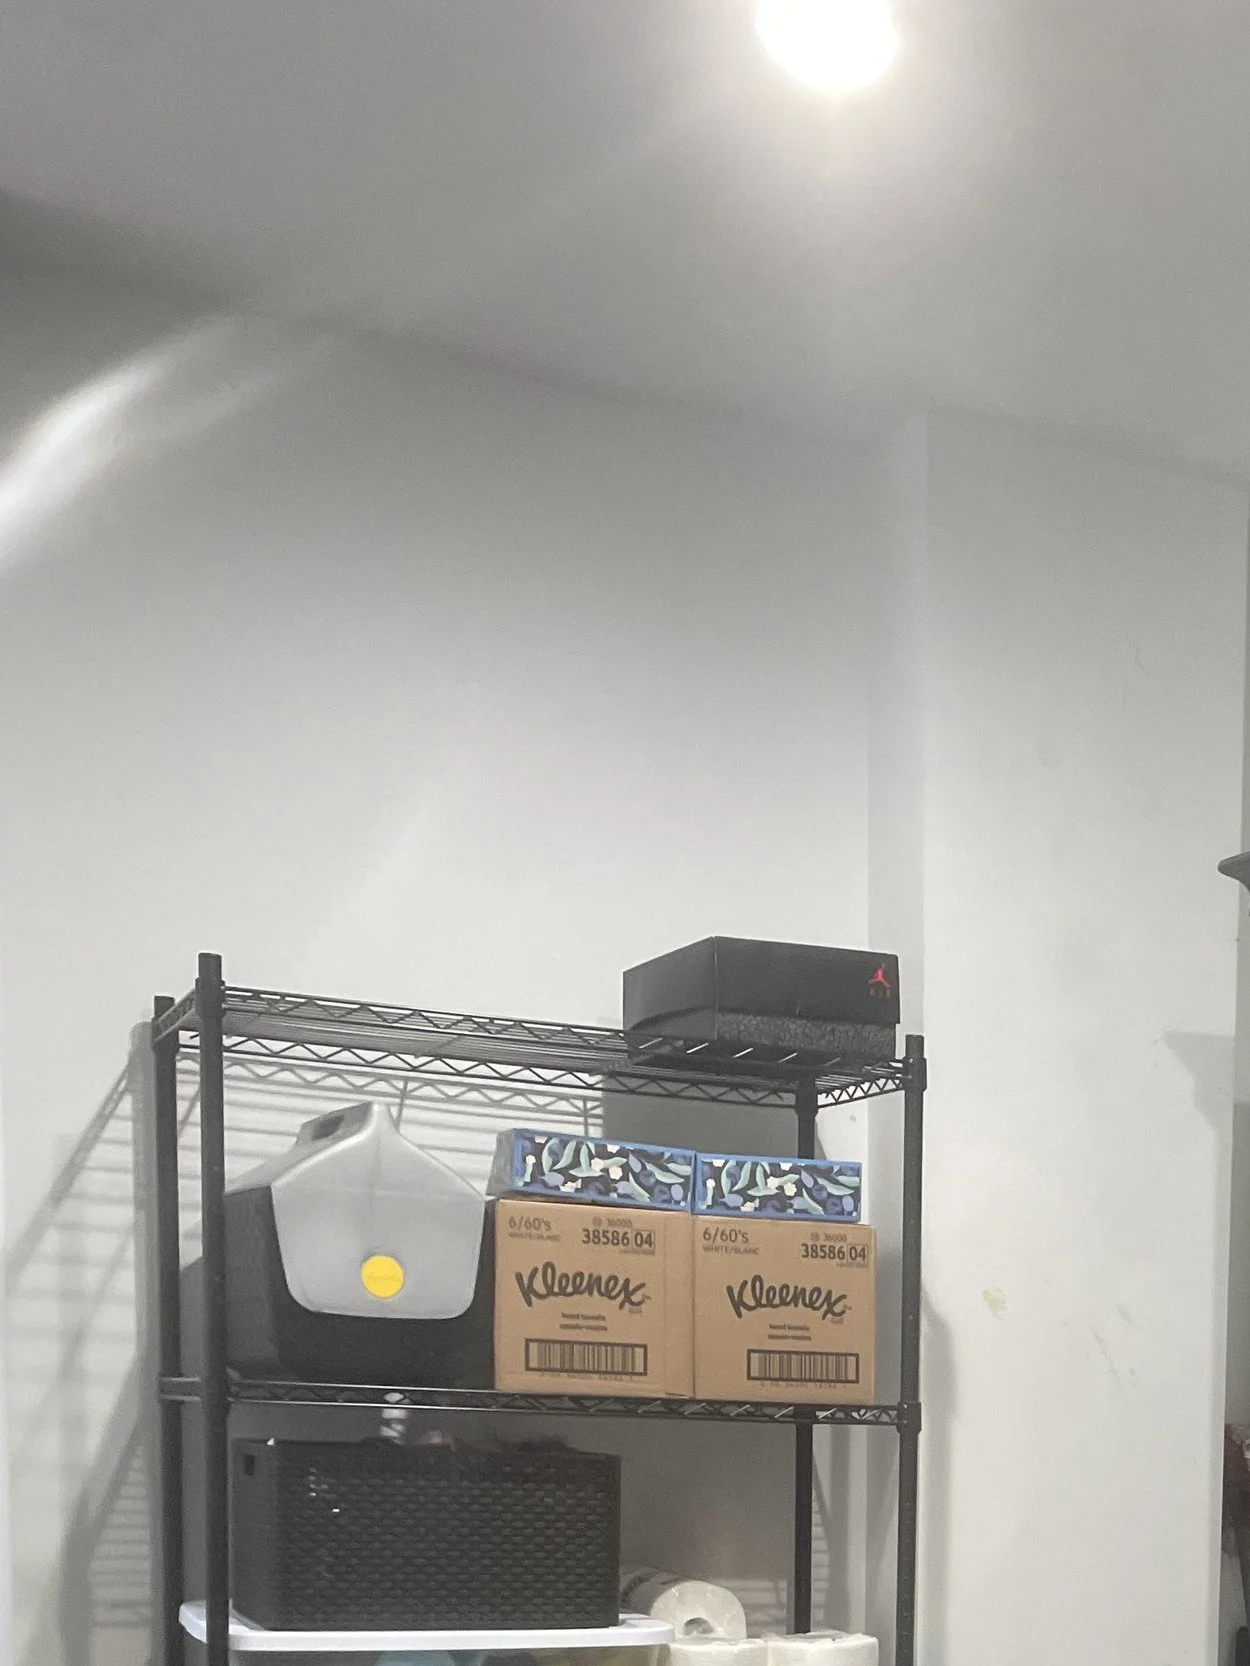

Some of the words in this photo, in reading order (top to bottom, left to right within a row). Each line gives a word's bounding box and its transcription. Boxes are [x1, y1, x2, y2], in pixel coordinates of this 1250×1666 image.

[508, 1215, 552, 1230] 6/60's
[582, 1227, 630, 1247] 38586
[634, 1231, 654, 1248] 04
[702, 1226, 749, 1243] 6/60's
[801, 1243, 846, 1261] 38586
[849, 1246, 867, 1262] 04
[514, 1261, 646, 1311] Kleenex
[726, 1274, 848, 1321] Kleenex
